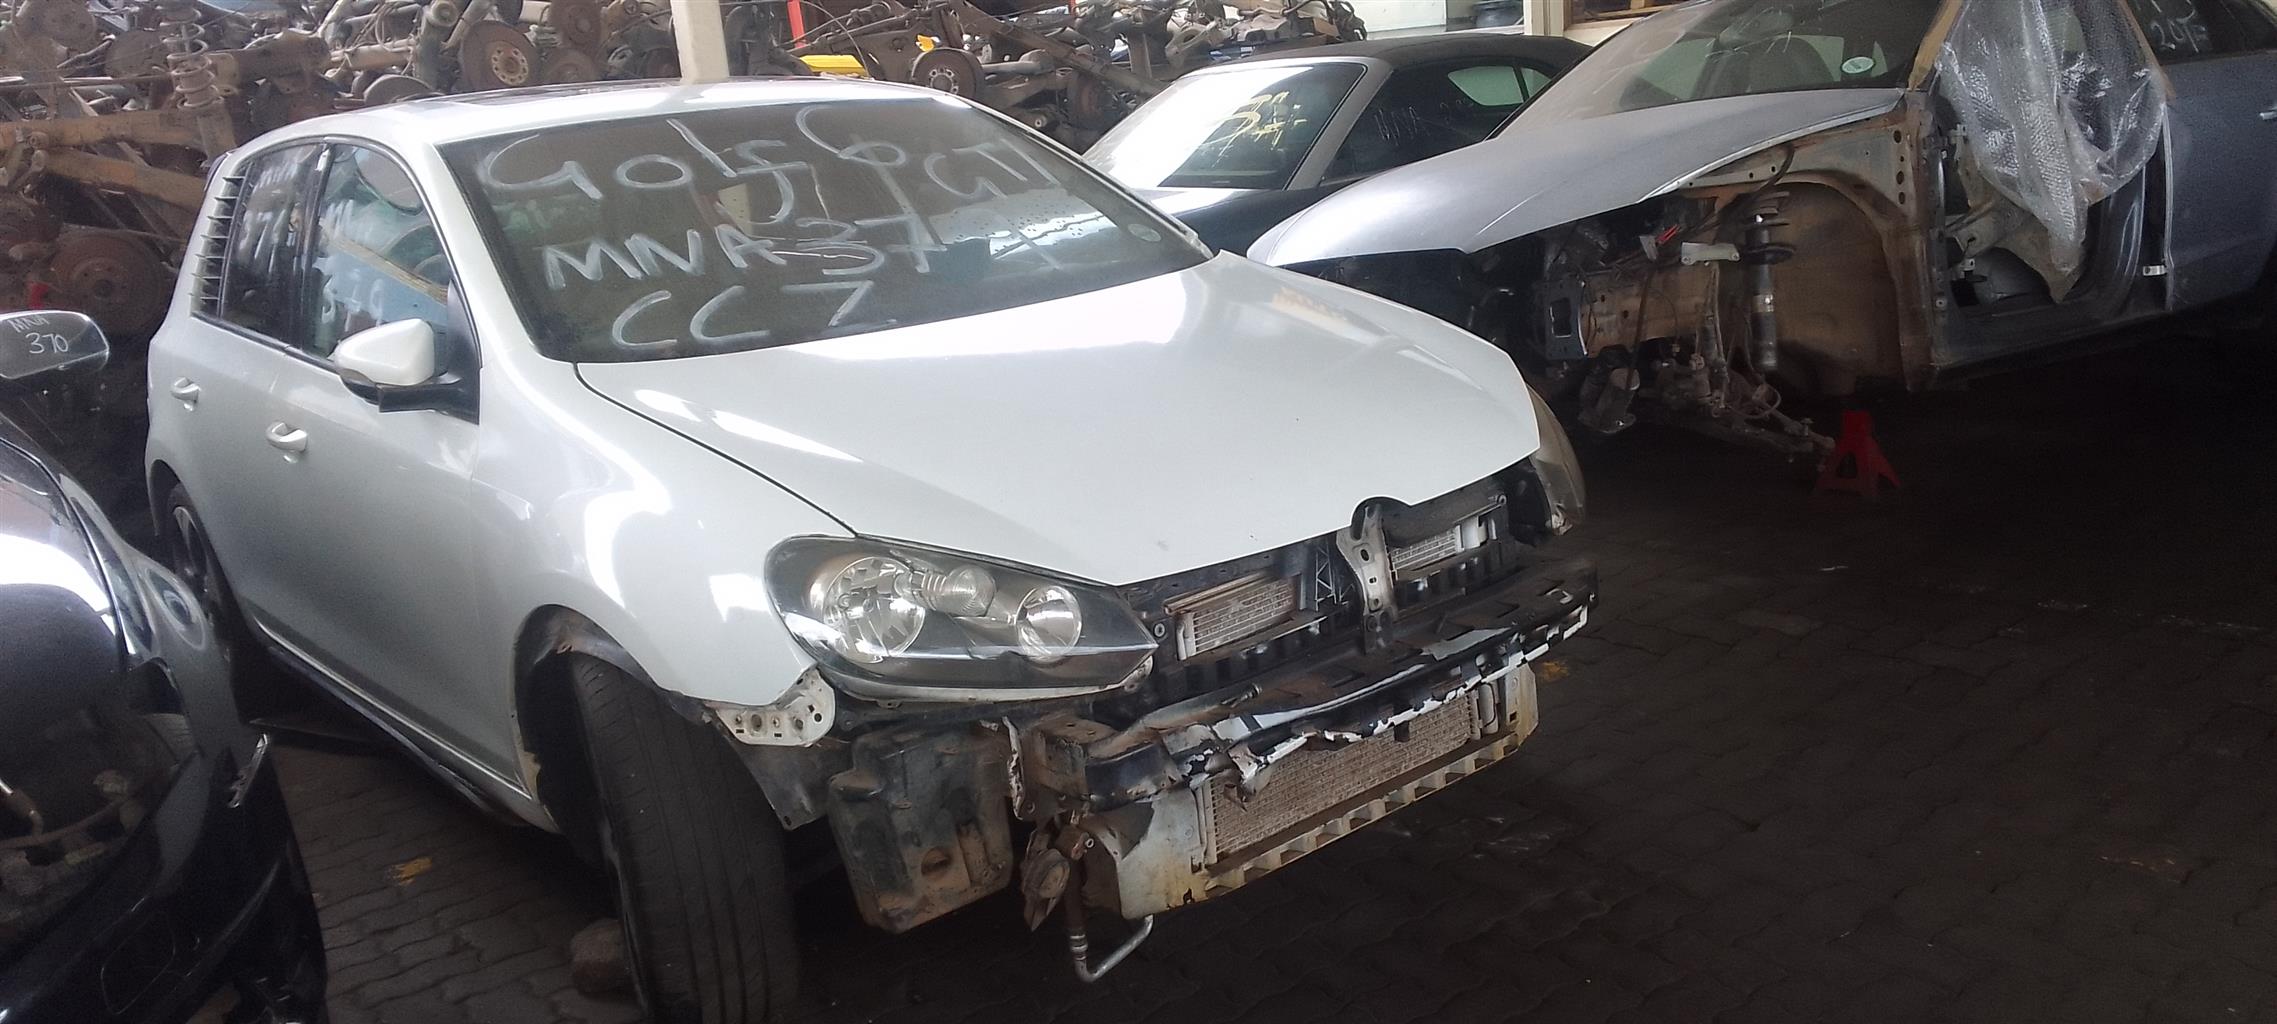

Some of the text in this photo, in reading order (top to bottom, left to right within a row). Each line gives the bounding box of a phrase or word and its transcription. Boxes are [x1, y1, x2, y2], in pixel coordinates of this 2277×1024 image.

[478, 103, 1061, 224] Golf 6 GTI
[25, 332, 68, 353] 370
